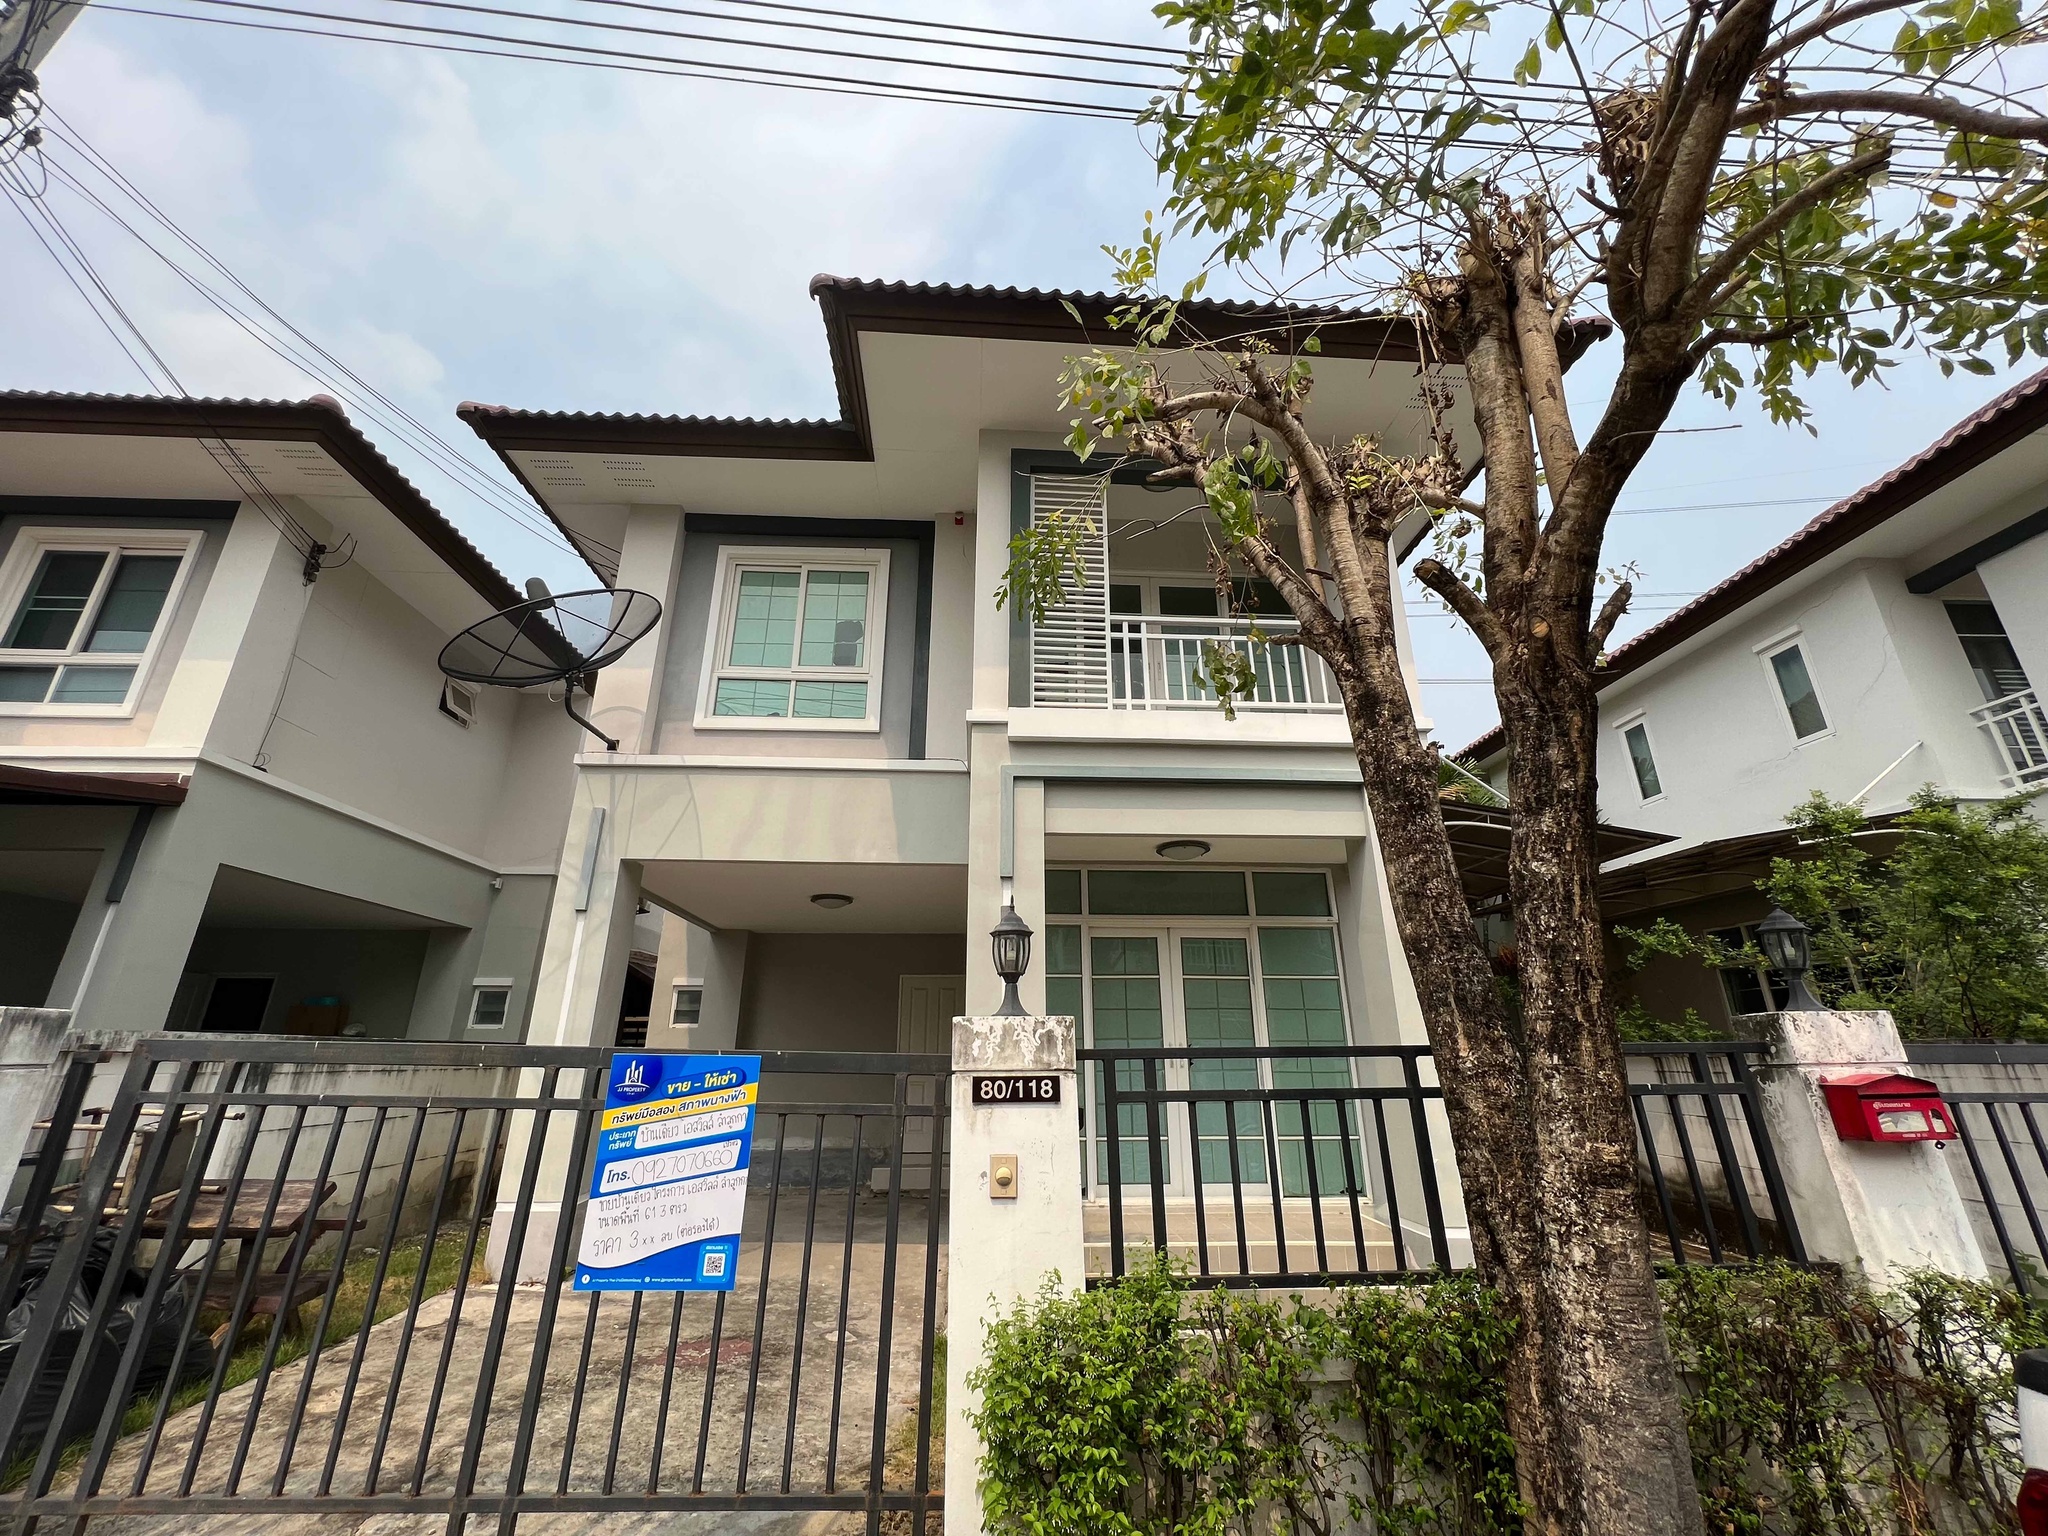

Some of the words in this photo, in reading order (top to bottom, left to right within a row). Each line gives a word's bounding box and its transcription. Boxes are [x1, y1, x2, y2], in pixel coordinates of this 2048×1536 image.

[667, 1080, 691, 1094] ขาย
[704, 1071, 737, 1088] ให้เช่า
[980, 1079, 1053, 1099] 80/118
[611, 1106, 675, 1125] ทรัพย์มือสอง
[678, 1089, 746, 1112] สภาพนางฟ้า
[608, 1129, 636, 1140] ประเภท
[608, 1138, 632, 1150] ทรัพย์
[606, 1168, 631, 1183] โทร.
[631, 1149, 733, 1185] 0927070660
[593, 1237, 620, 1257] ราคา
